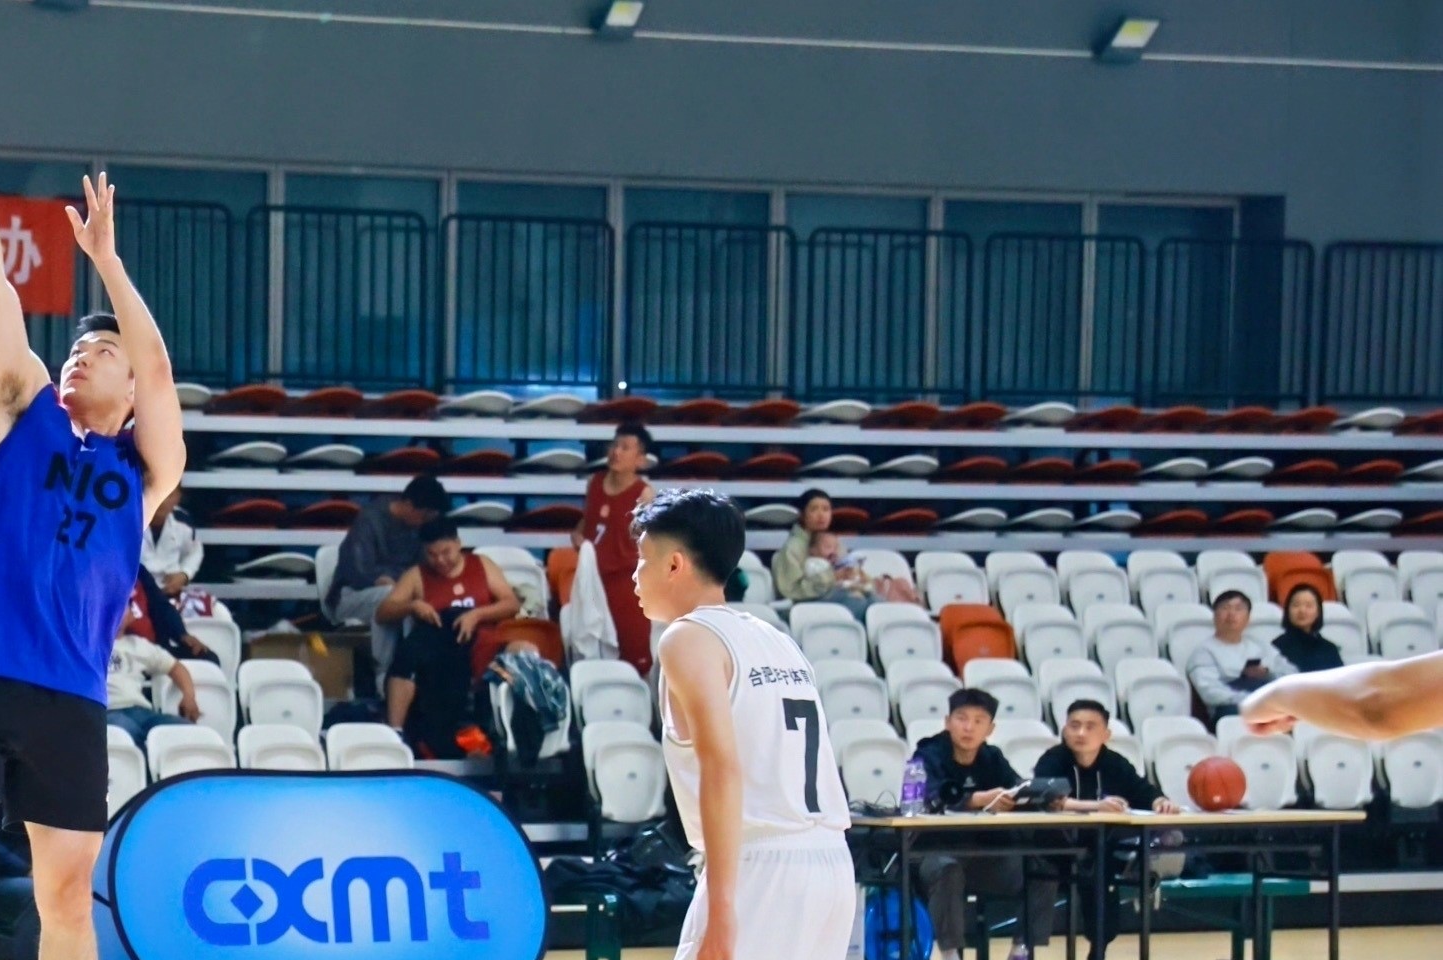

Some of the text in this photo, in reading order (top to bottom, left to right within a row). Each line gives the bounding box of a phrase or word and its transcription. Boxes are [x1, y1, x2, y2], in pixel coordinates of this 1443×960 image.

[44, 451, 130, 510] NIO
[56, 504, 97, 549] 27
[782, 698, 821, 813] 7
